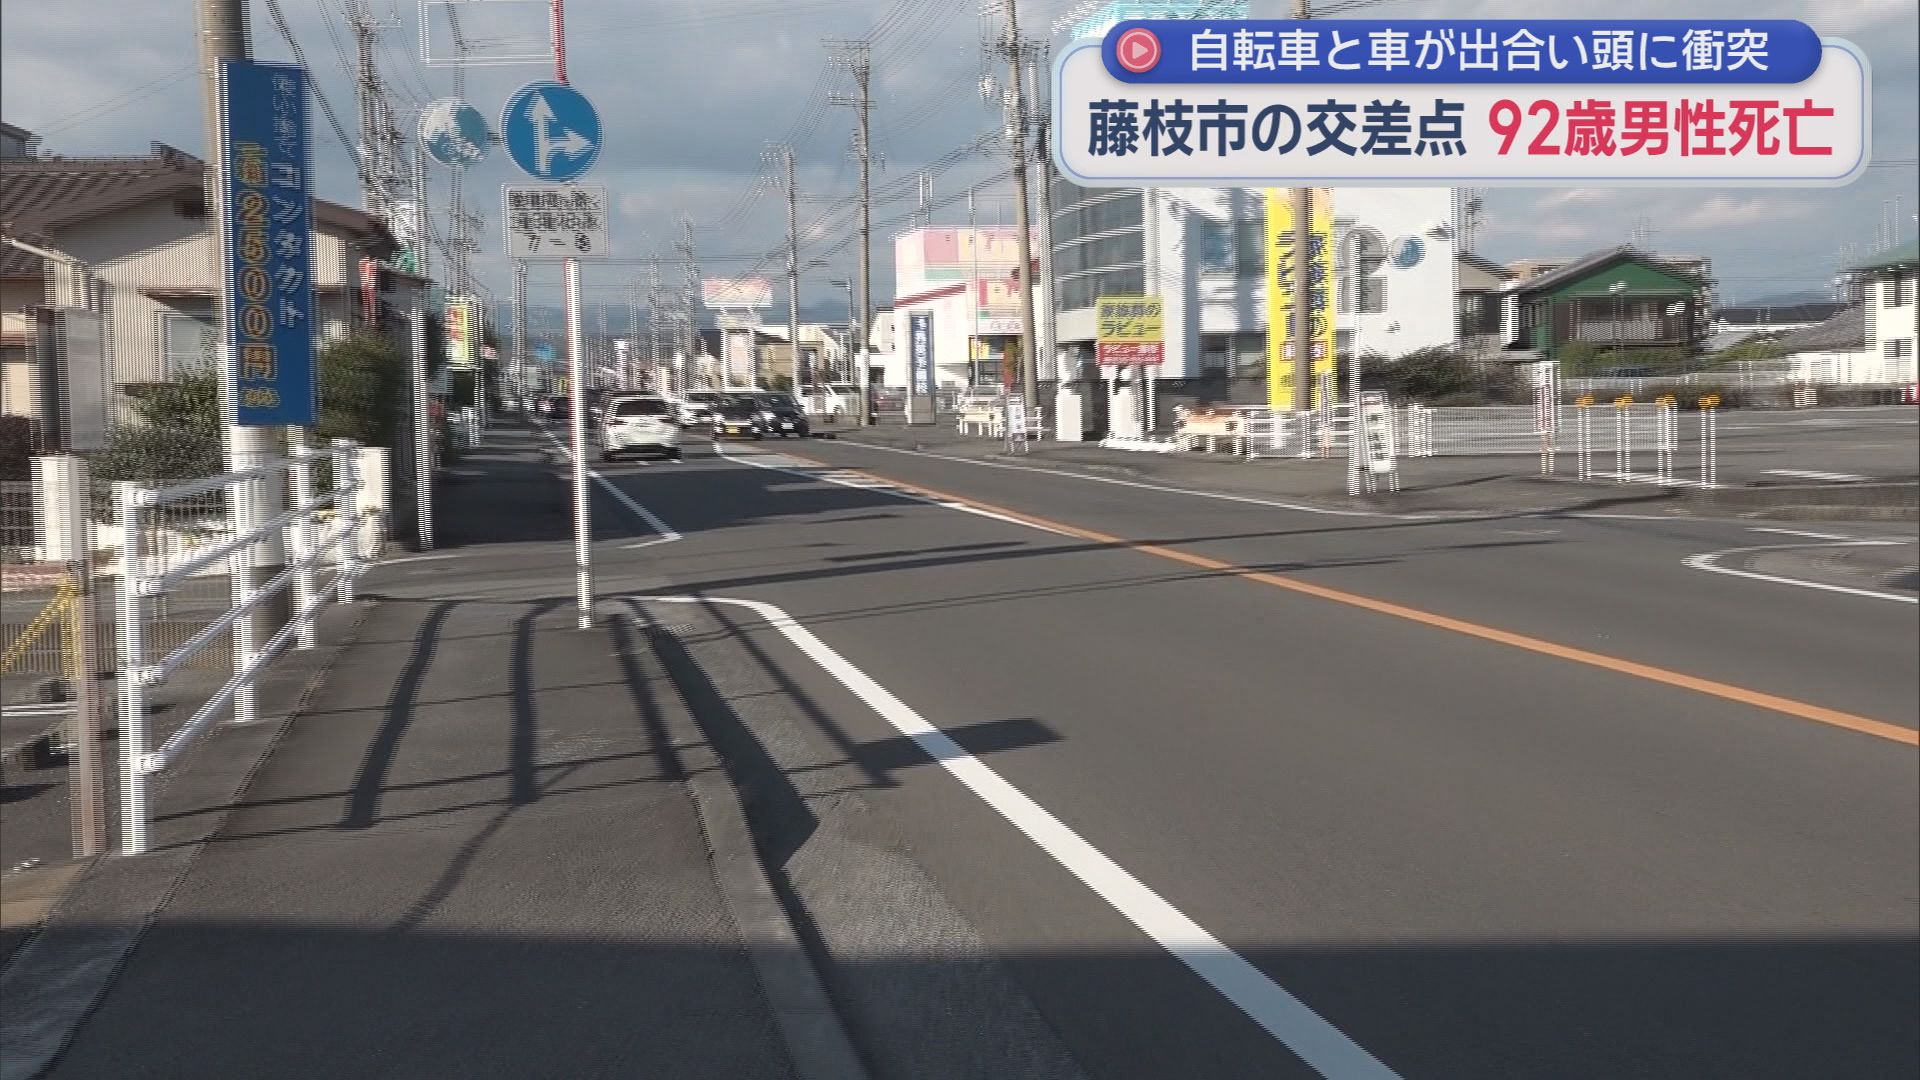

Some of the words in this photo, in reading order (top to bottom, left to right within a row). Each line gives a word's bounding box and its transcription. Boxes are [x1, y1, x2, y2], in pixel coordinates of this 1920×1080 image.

[509, 191, 601, 210] 軽車両を除く
[1101, 303, 1160, 319] 家族葬の
[1101, 320, 1160, 336] ラビュー
